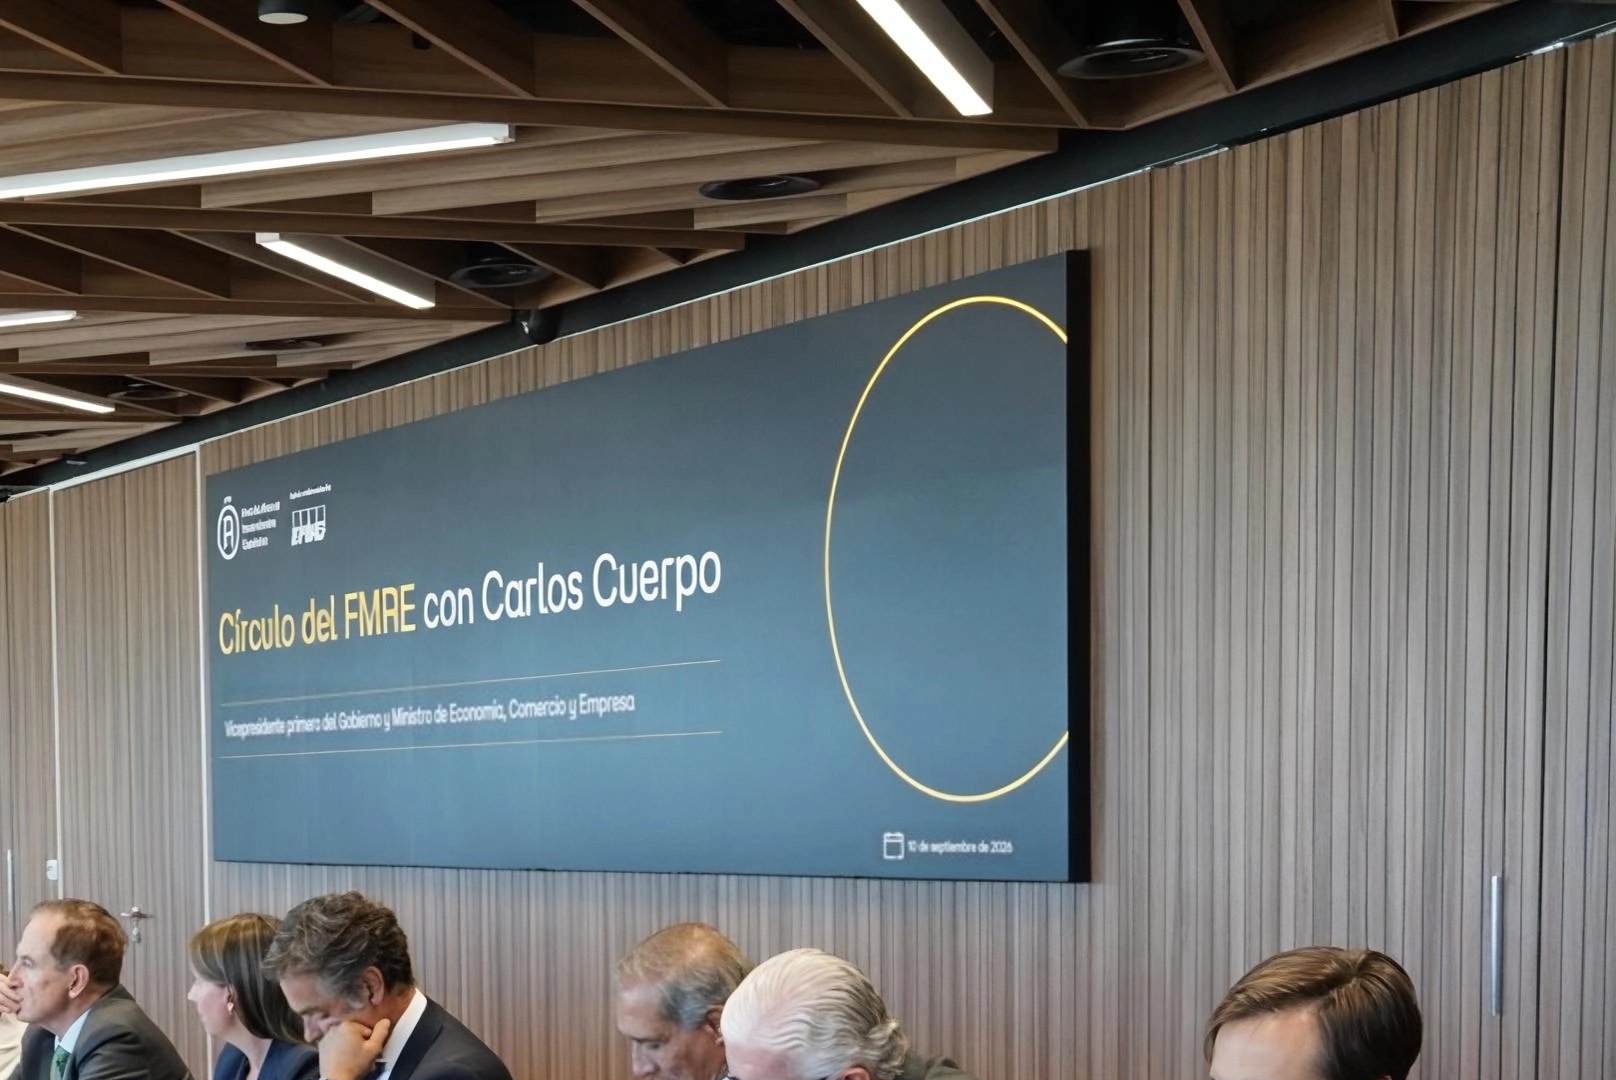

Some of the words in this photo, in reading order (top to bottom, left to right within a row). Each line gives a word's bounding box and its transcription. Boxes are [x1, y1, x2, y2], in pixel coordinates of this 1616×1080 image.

[218, 603, 296, 656] Círculo
[301, 594, 339, 645] del
[344, 583, 417, 640] FMRE
[423, 587, 474, 629] con
[482, 562, 583, 621] Carlos
[592, 551, 722, 612] Cuerpo
[322, 711, 337, 732] del
[338, 709, 382, 730] Gobierno
[383, 712, 391, 733] y
[391, 705, 433, 728] Ministro
[434, 703, 448, 724] de
[508, 694, 567, 720] Comercio
[568, 699, 577, 721] y
[579, 693, 635, 718] Empresa
